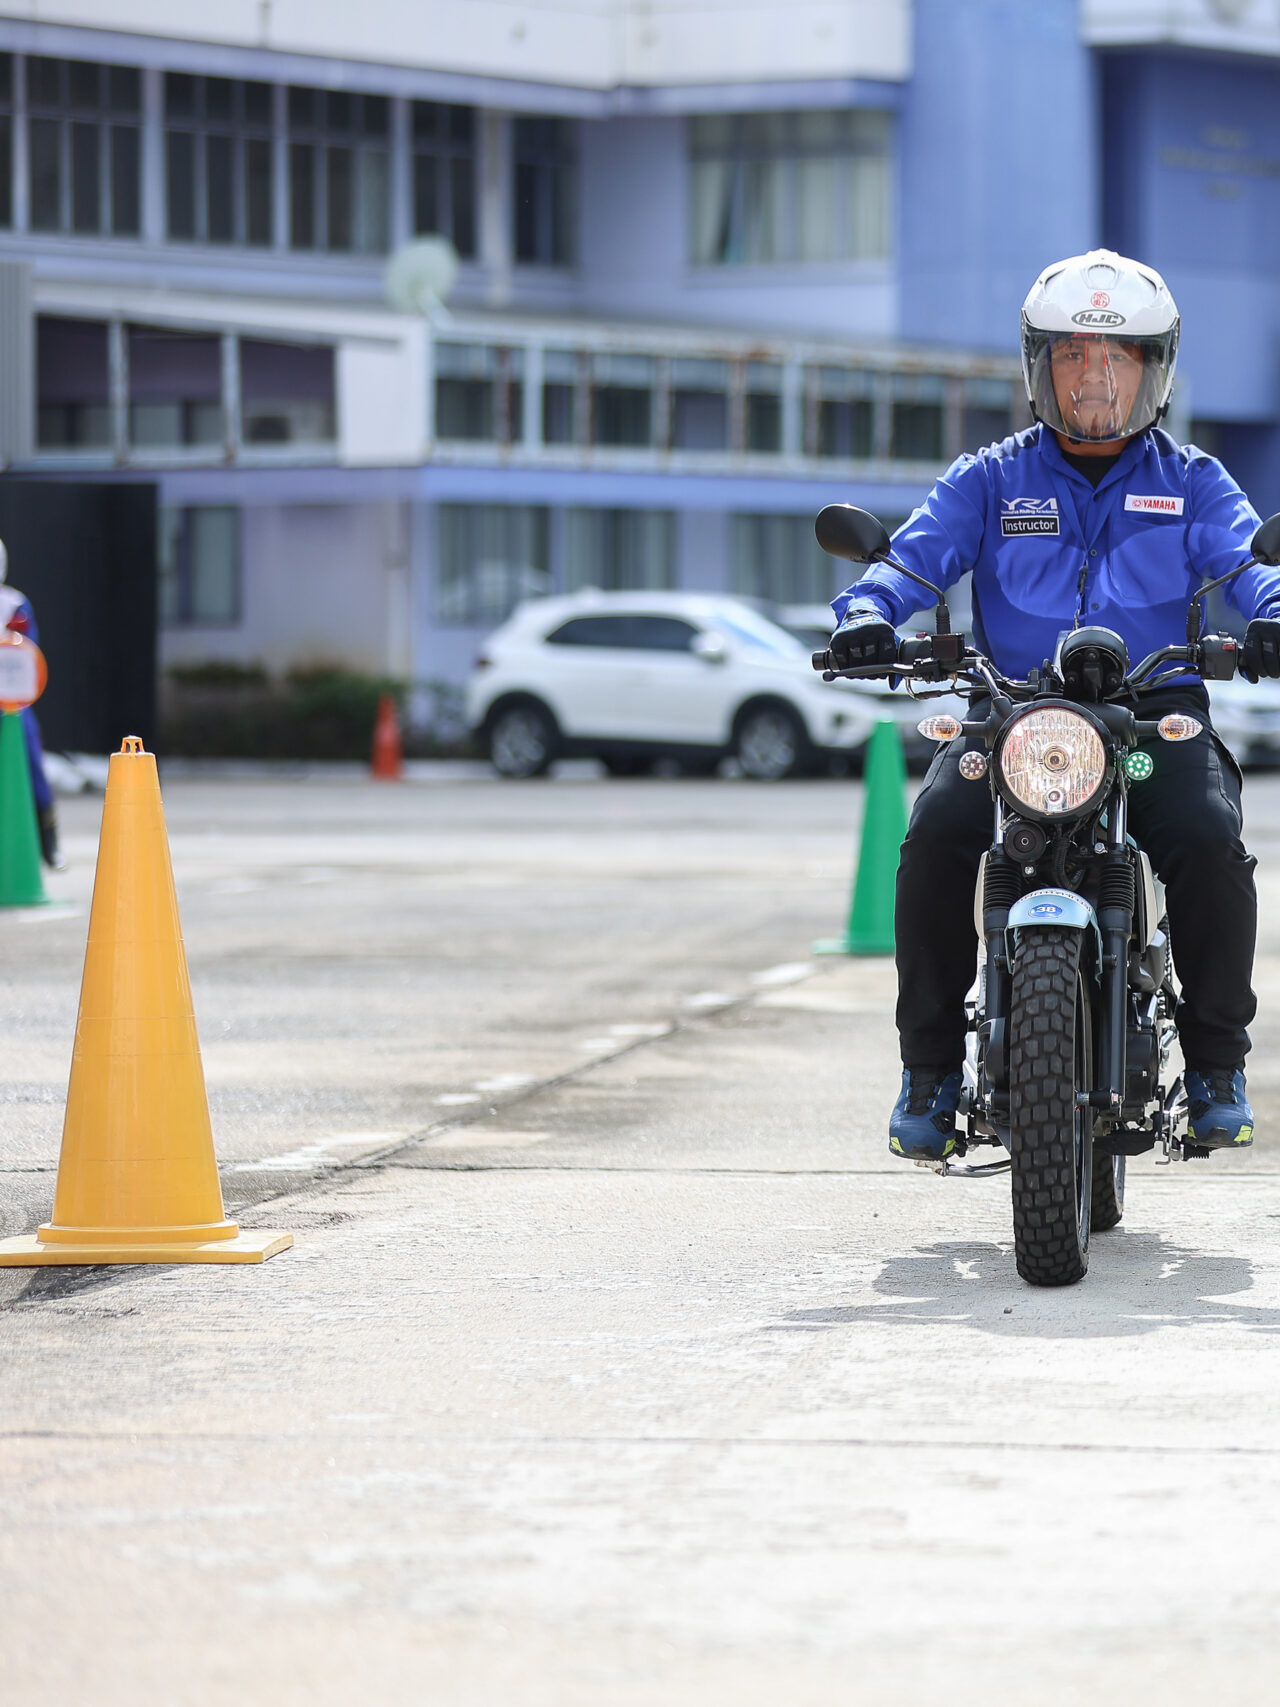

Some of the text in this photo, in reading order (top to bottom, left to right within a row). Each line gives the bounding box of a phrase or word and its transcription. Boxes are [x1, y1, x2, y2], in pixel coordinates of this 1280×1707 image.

[1079, 313, 1118, 323] HJC
[1144, 499, 1176, 510] YAMAHA
[1004, 520, 1055, 531] Instructor
